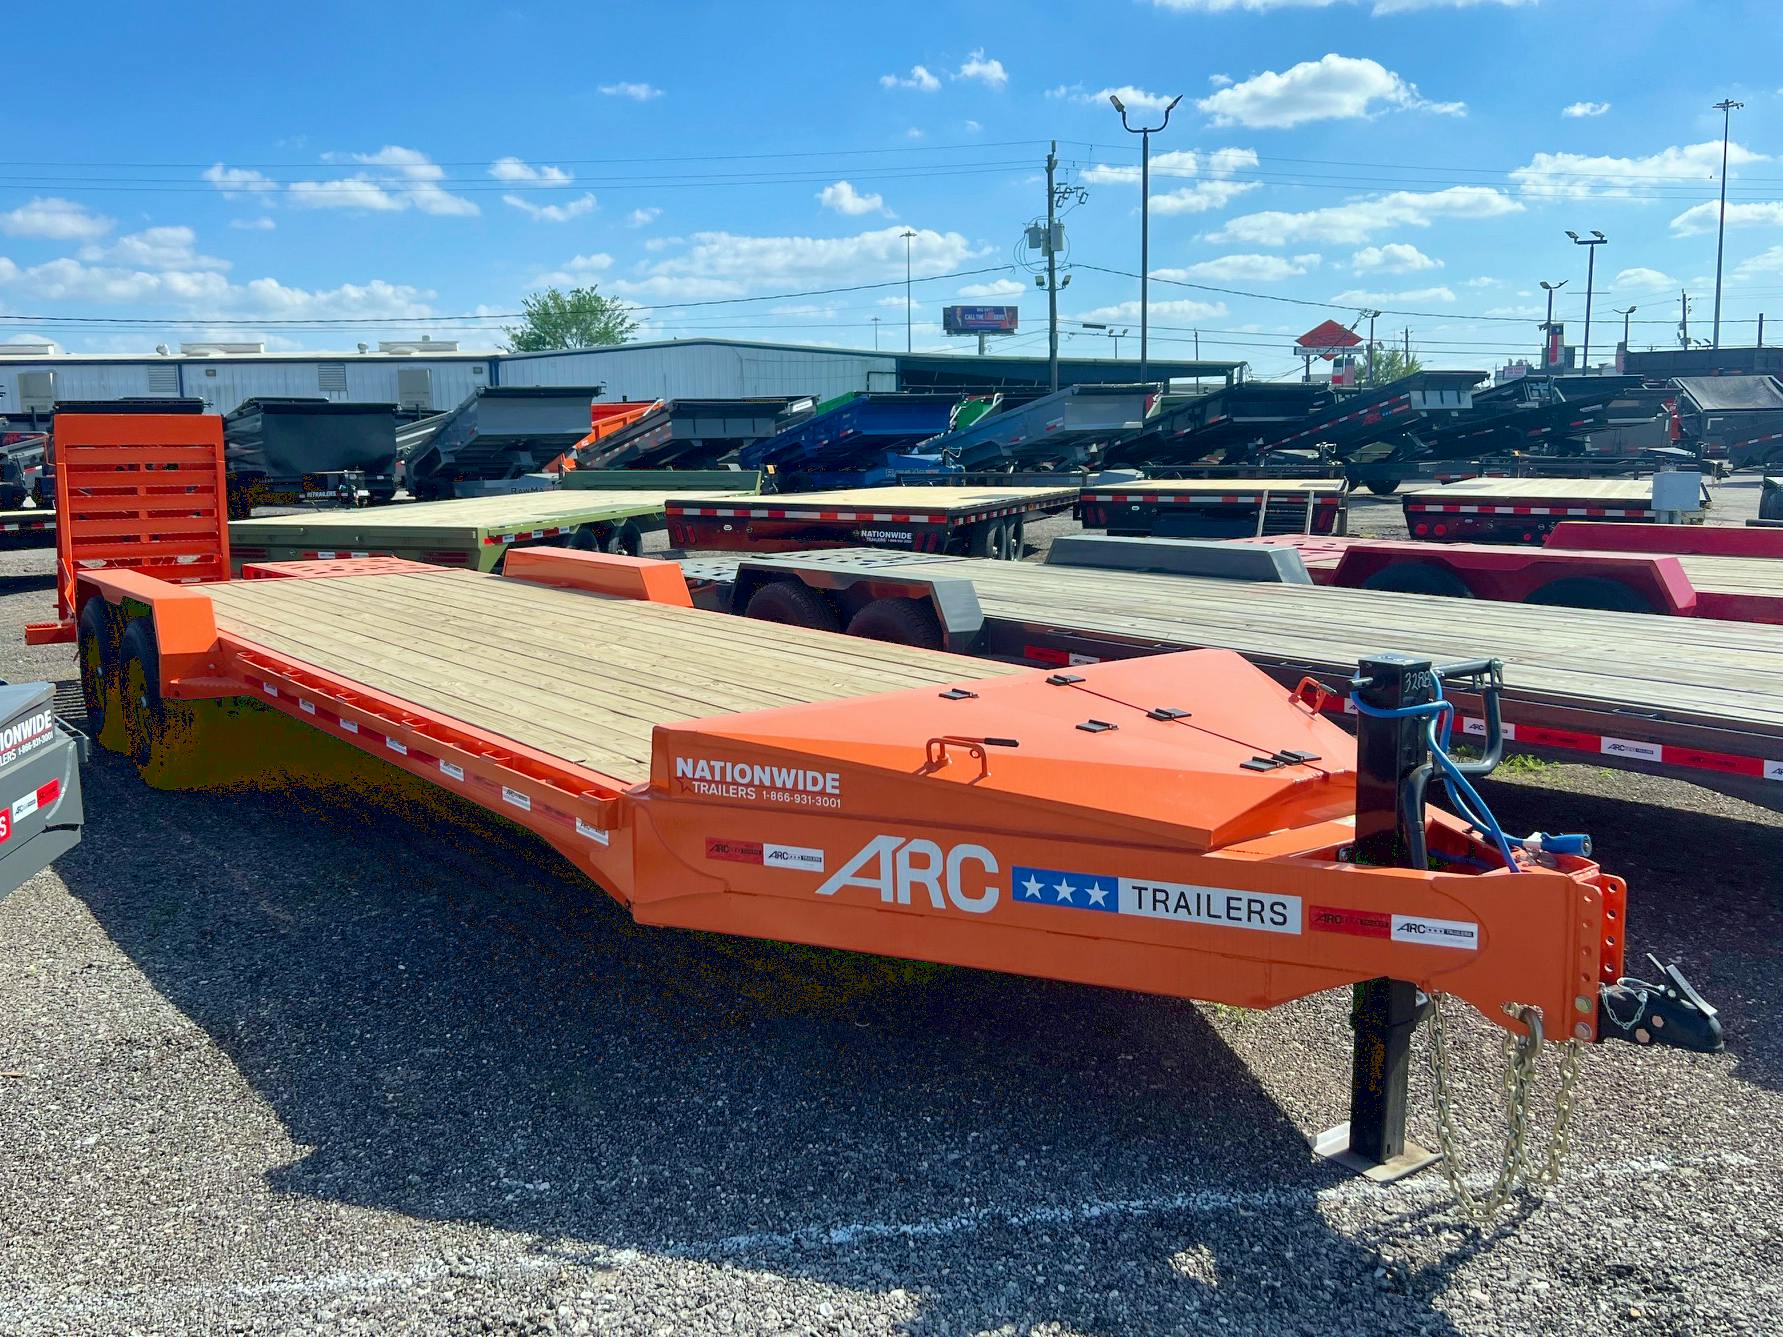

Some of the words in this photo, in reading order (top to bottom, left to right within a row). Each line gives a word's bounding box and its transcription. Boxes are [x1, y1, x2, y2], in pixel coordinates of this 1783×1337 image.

[861, 529, 912, 539] NATIONWIDE
[1608, 743, 1625, 752] ARC
[676, 757, 840, 795] NATIONWIDE
[692, 781, 756, 800] TRAILERS
[762, 790, 841, 809] 1-866-931-3001
[768, 850, 789, 861] ARC
[815, 834, 1000, 914] ARC
[1131, 885, 1288, 926] TRAILERS
[1314, 912, 1342, 925] ARC
[1397, 922, 1426, 934] ARC
